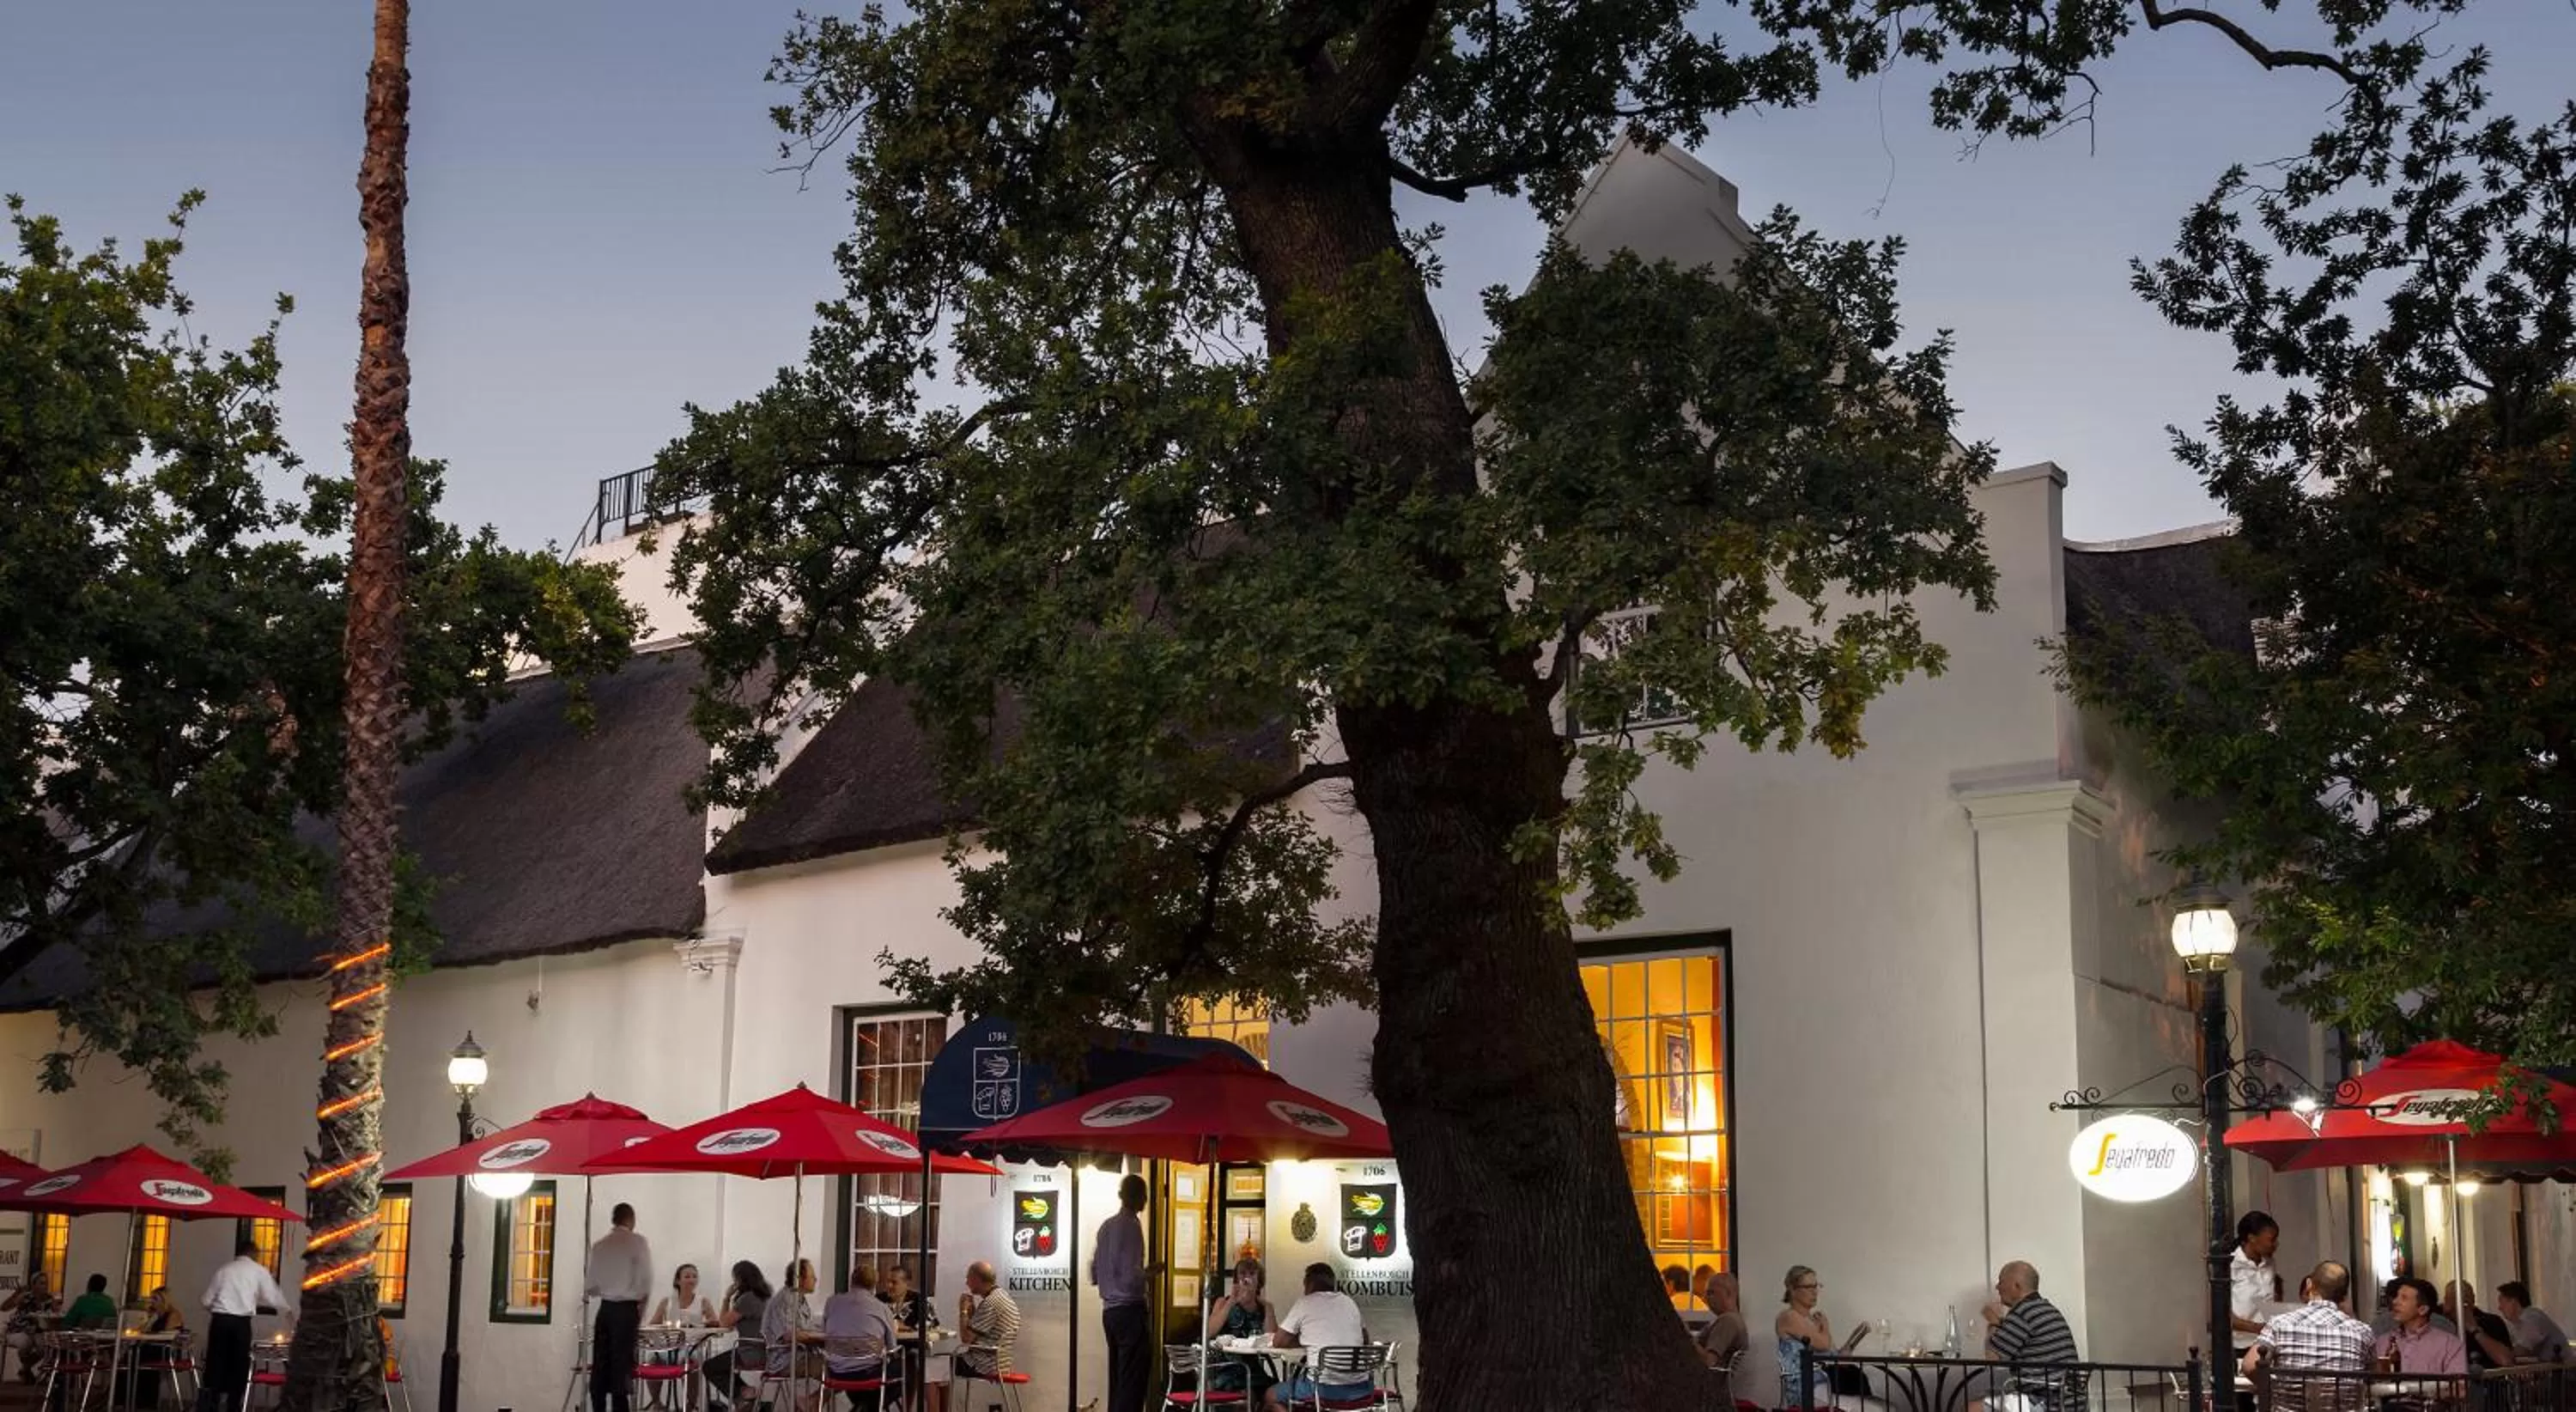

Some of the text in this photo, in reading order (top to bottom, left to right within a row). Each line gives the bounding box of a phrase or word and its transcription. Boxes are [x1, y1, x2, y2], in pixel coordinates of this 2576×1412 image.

[2088, 1133, 2176, 1176] Segafredo
[1363, 1167, 1386, 1176] 1706
[1340, 1269, 1410, 1279] STELLENBOSCH
[1009, 1278, 1072, 1291] KITCHEN
[1337, 1281, 1413, 1296] KOMBUIS
